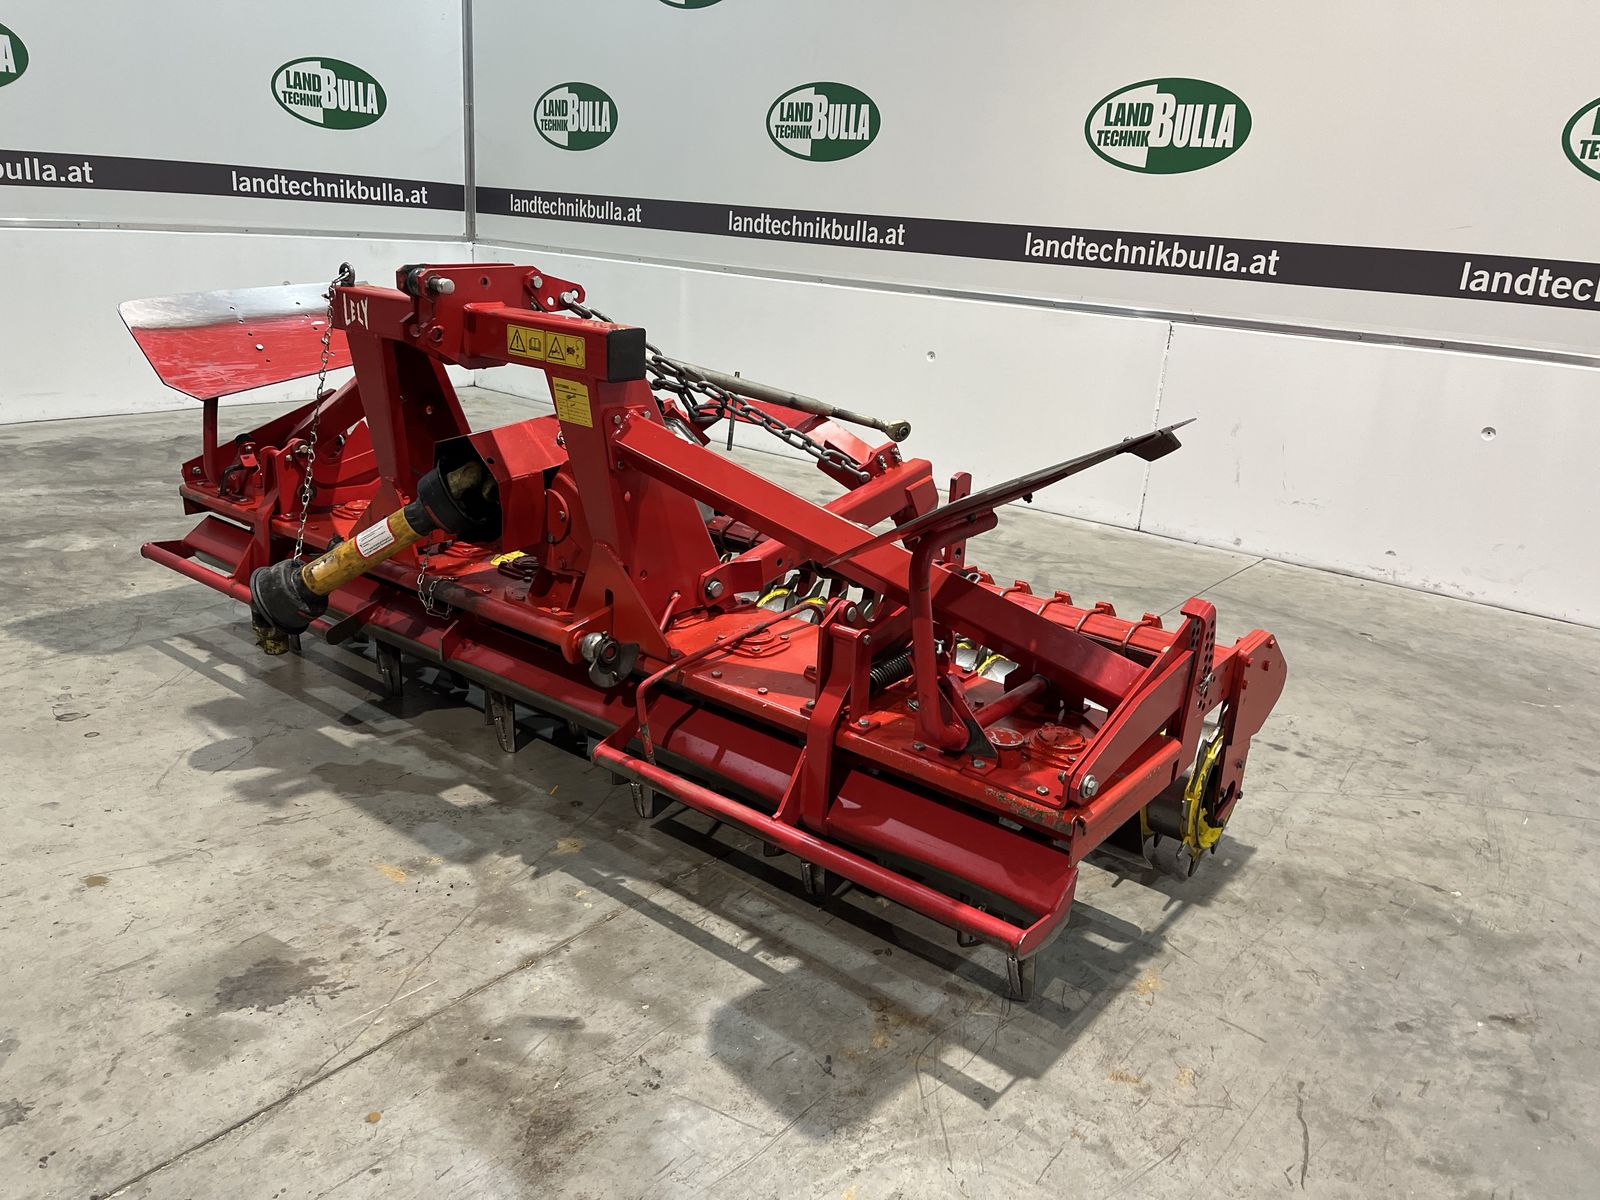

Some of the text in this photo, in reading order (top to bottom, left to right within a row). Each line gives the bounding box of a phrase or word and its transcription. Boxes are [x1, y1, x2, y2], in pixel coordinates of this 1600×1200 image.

[285, 69, 322, 92] LAND
[321, 67, 379, 115] BULLA
[281, 90, 323, 108] TECHNIK
[543, 99, 568, 117] LAND
[567, 92, 611, 133] BULLA
[779, 102, 814, 122] LAND
[540, 118, 568, 132] TECHNIK
[811, 94, 870, 141] BULLA
[1104, 102, 1154, 127] LAND
[1148, 92, 1237, 148] BULLA
[775, 124, 812, 139] TECHNIK
[1096, 130, 1151, 147] TECHNIK
[231, 170, 428, 205] landtechnikbulla.at
[510, 193, 642, 223] landtechnikbulla.at
[728, 210, 906, 246] landtechnikbulla.at
[1024, 232, 1280, 276] landtechnikbulla.at
[342, 292, 369, 330] LELY
